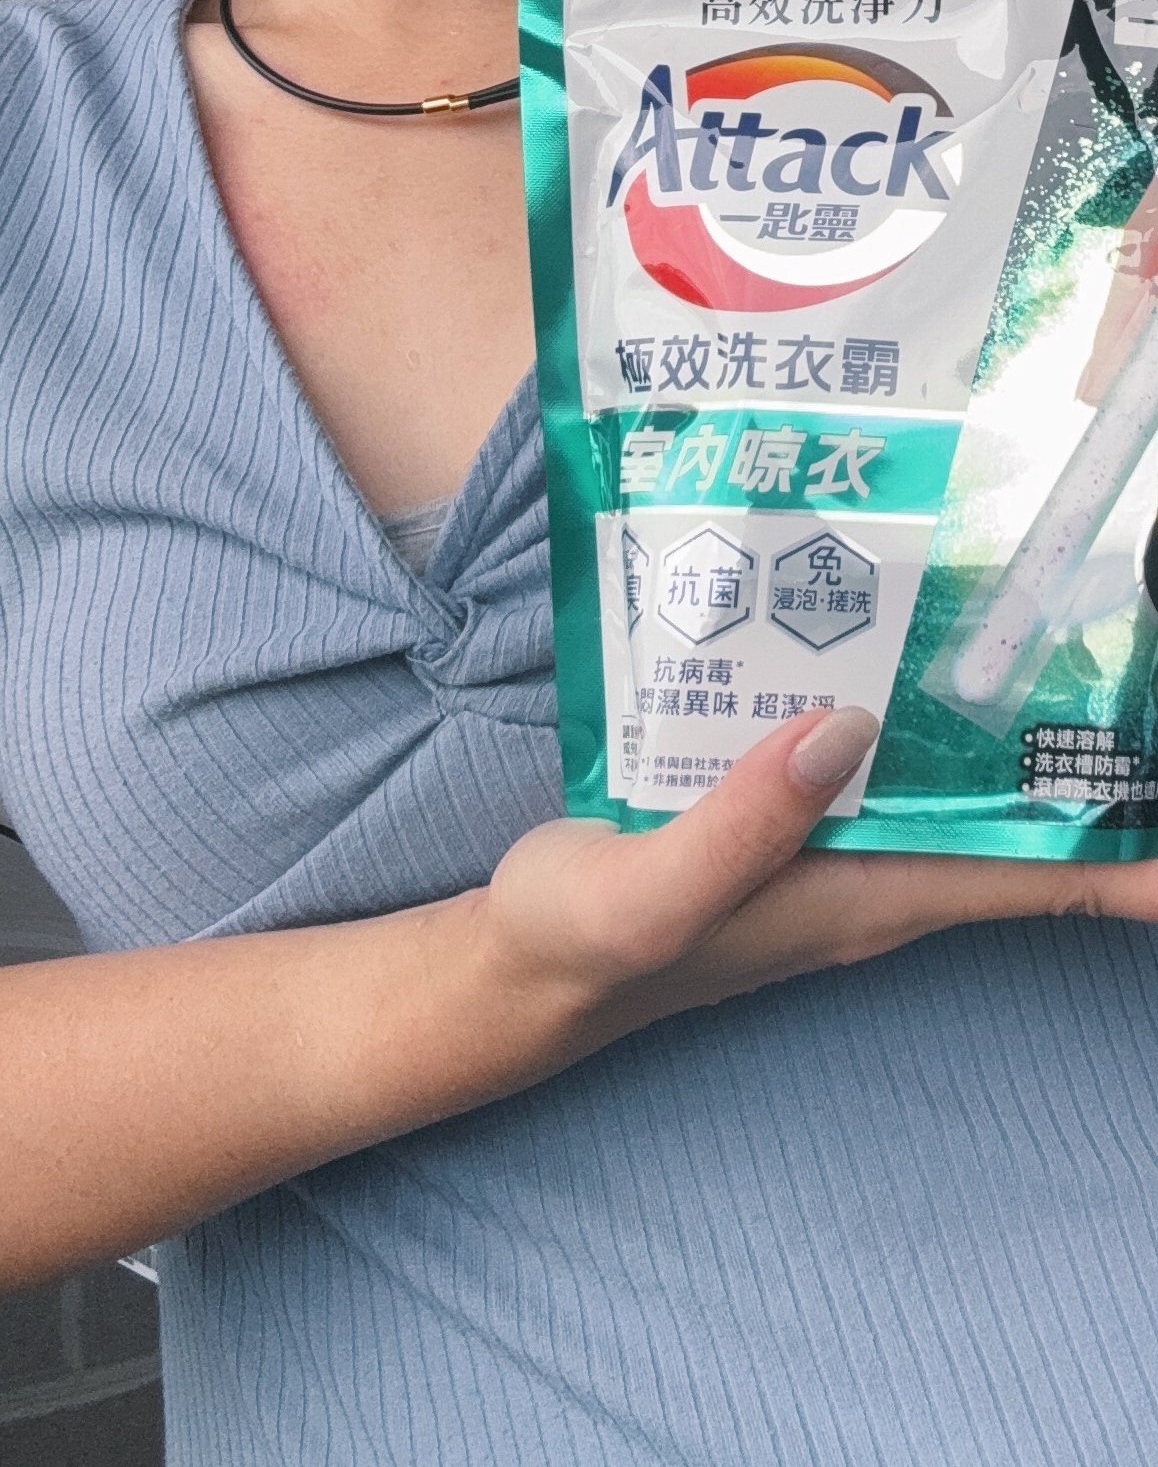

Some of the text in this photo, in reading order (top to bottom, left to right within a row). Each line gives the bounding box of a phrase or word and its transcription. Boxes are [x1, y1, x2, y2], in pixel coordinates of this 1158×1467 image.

[606, 63, 955, 207] Attack
[720, 203, 860, 244] 一匙靈
[615, 330, 900, 397] 極效洗衣霸
[619, 423, 886, 501] 室內晾衣
[668, 565, 743, 609] 抗菌
[807, 545, 842, 587] 免
[1036, 728, 1115, 751] 快速溶解
